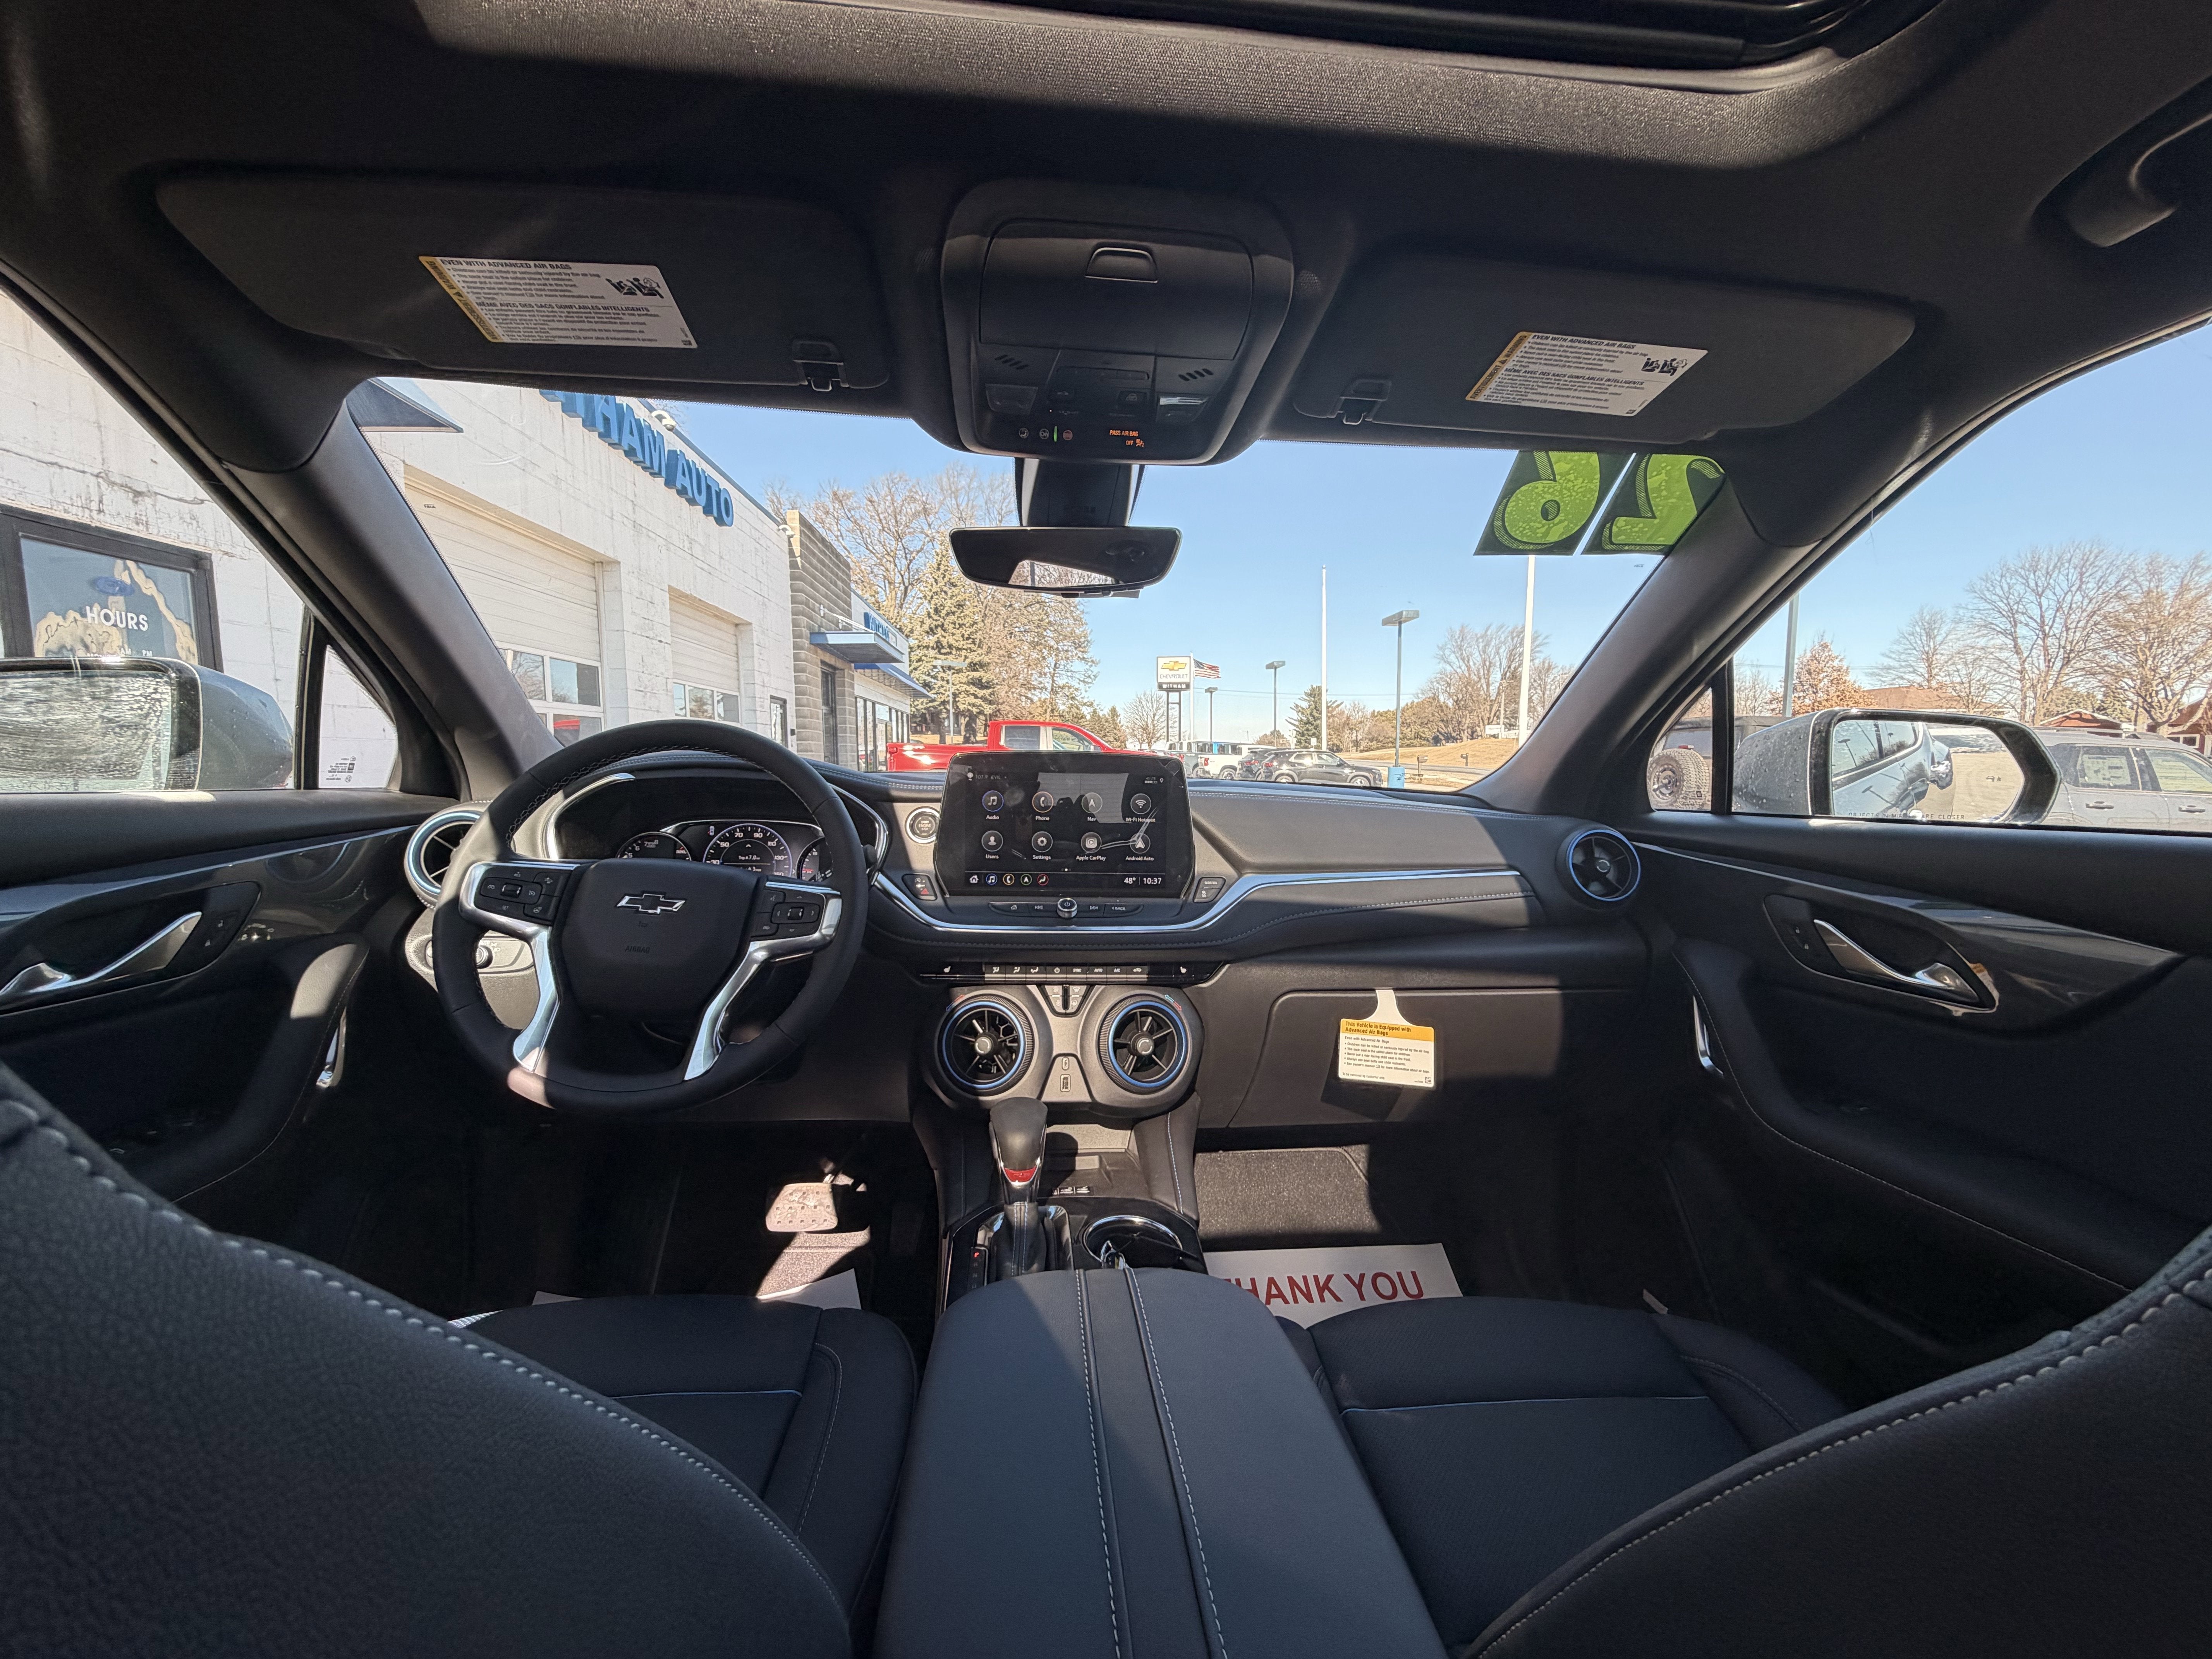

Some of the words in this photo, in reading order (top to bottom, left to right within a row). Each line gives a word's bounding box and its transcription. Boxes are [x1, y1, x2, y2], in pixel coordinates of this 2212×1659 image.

[665, 448, 734, 527] AUTO
[86, 606, 149, 631] HOURS
[1224, 1274, 1343, 1305] HANK
[1343, 1271, 1424, 1302] YOU
